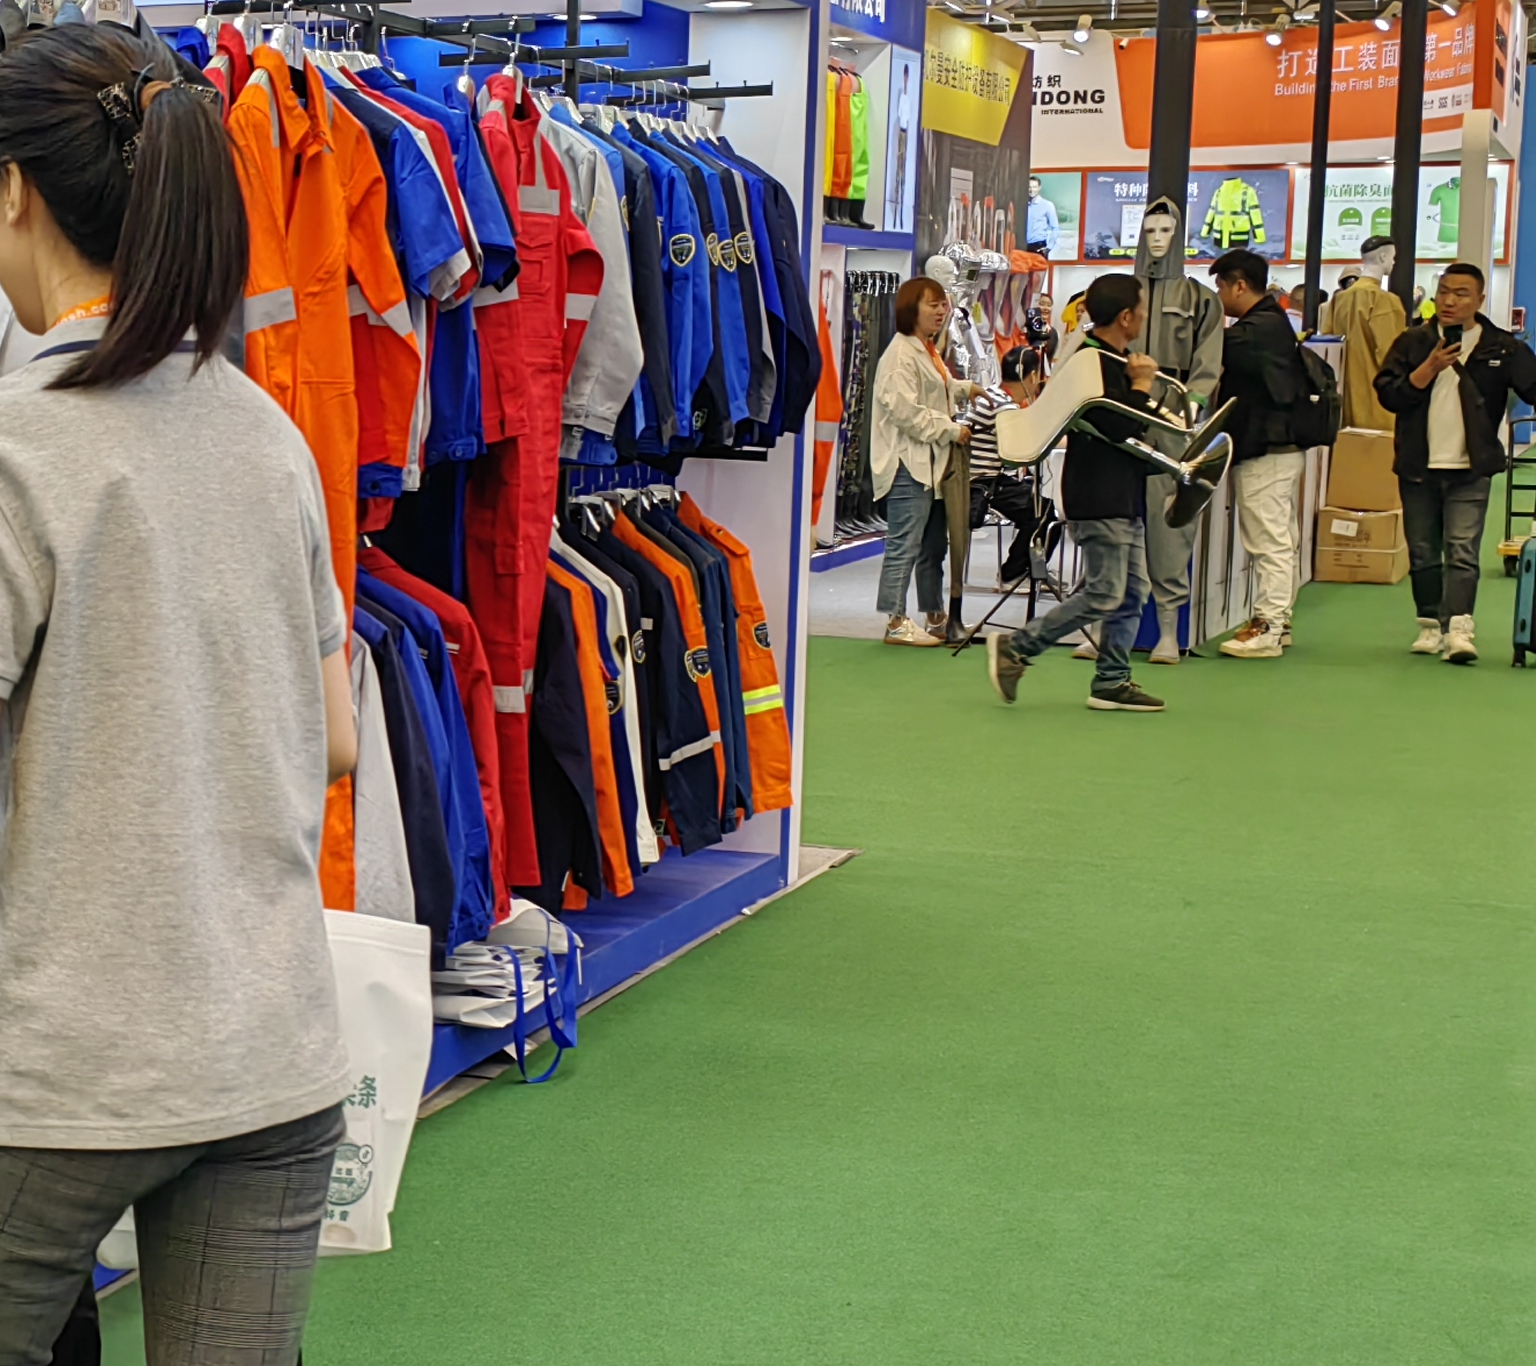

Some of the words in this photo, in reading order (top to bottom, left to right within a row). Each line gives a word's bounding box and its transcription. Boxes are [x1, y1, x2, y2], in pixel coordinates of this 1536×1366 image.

[1277, 23, 1474, 78] 打造工装面第一品牌
[1274, 82, 1316, 96] Buildin
[1349, 77, 1373, 91] First
[1041, 107, 1104, 115] INTERNATIONAL
